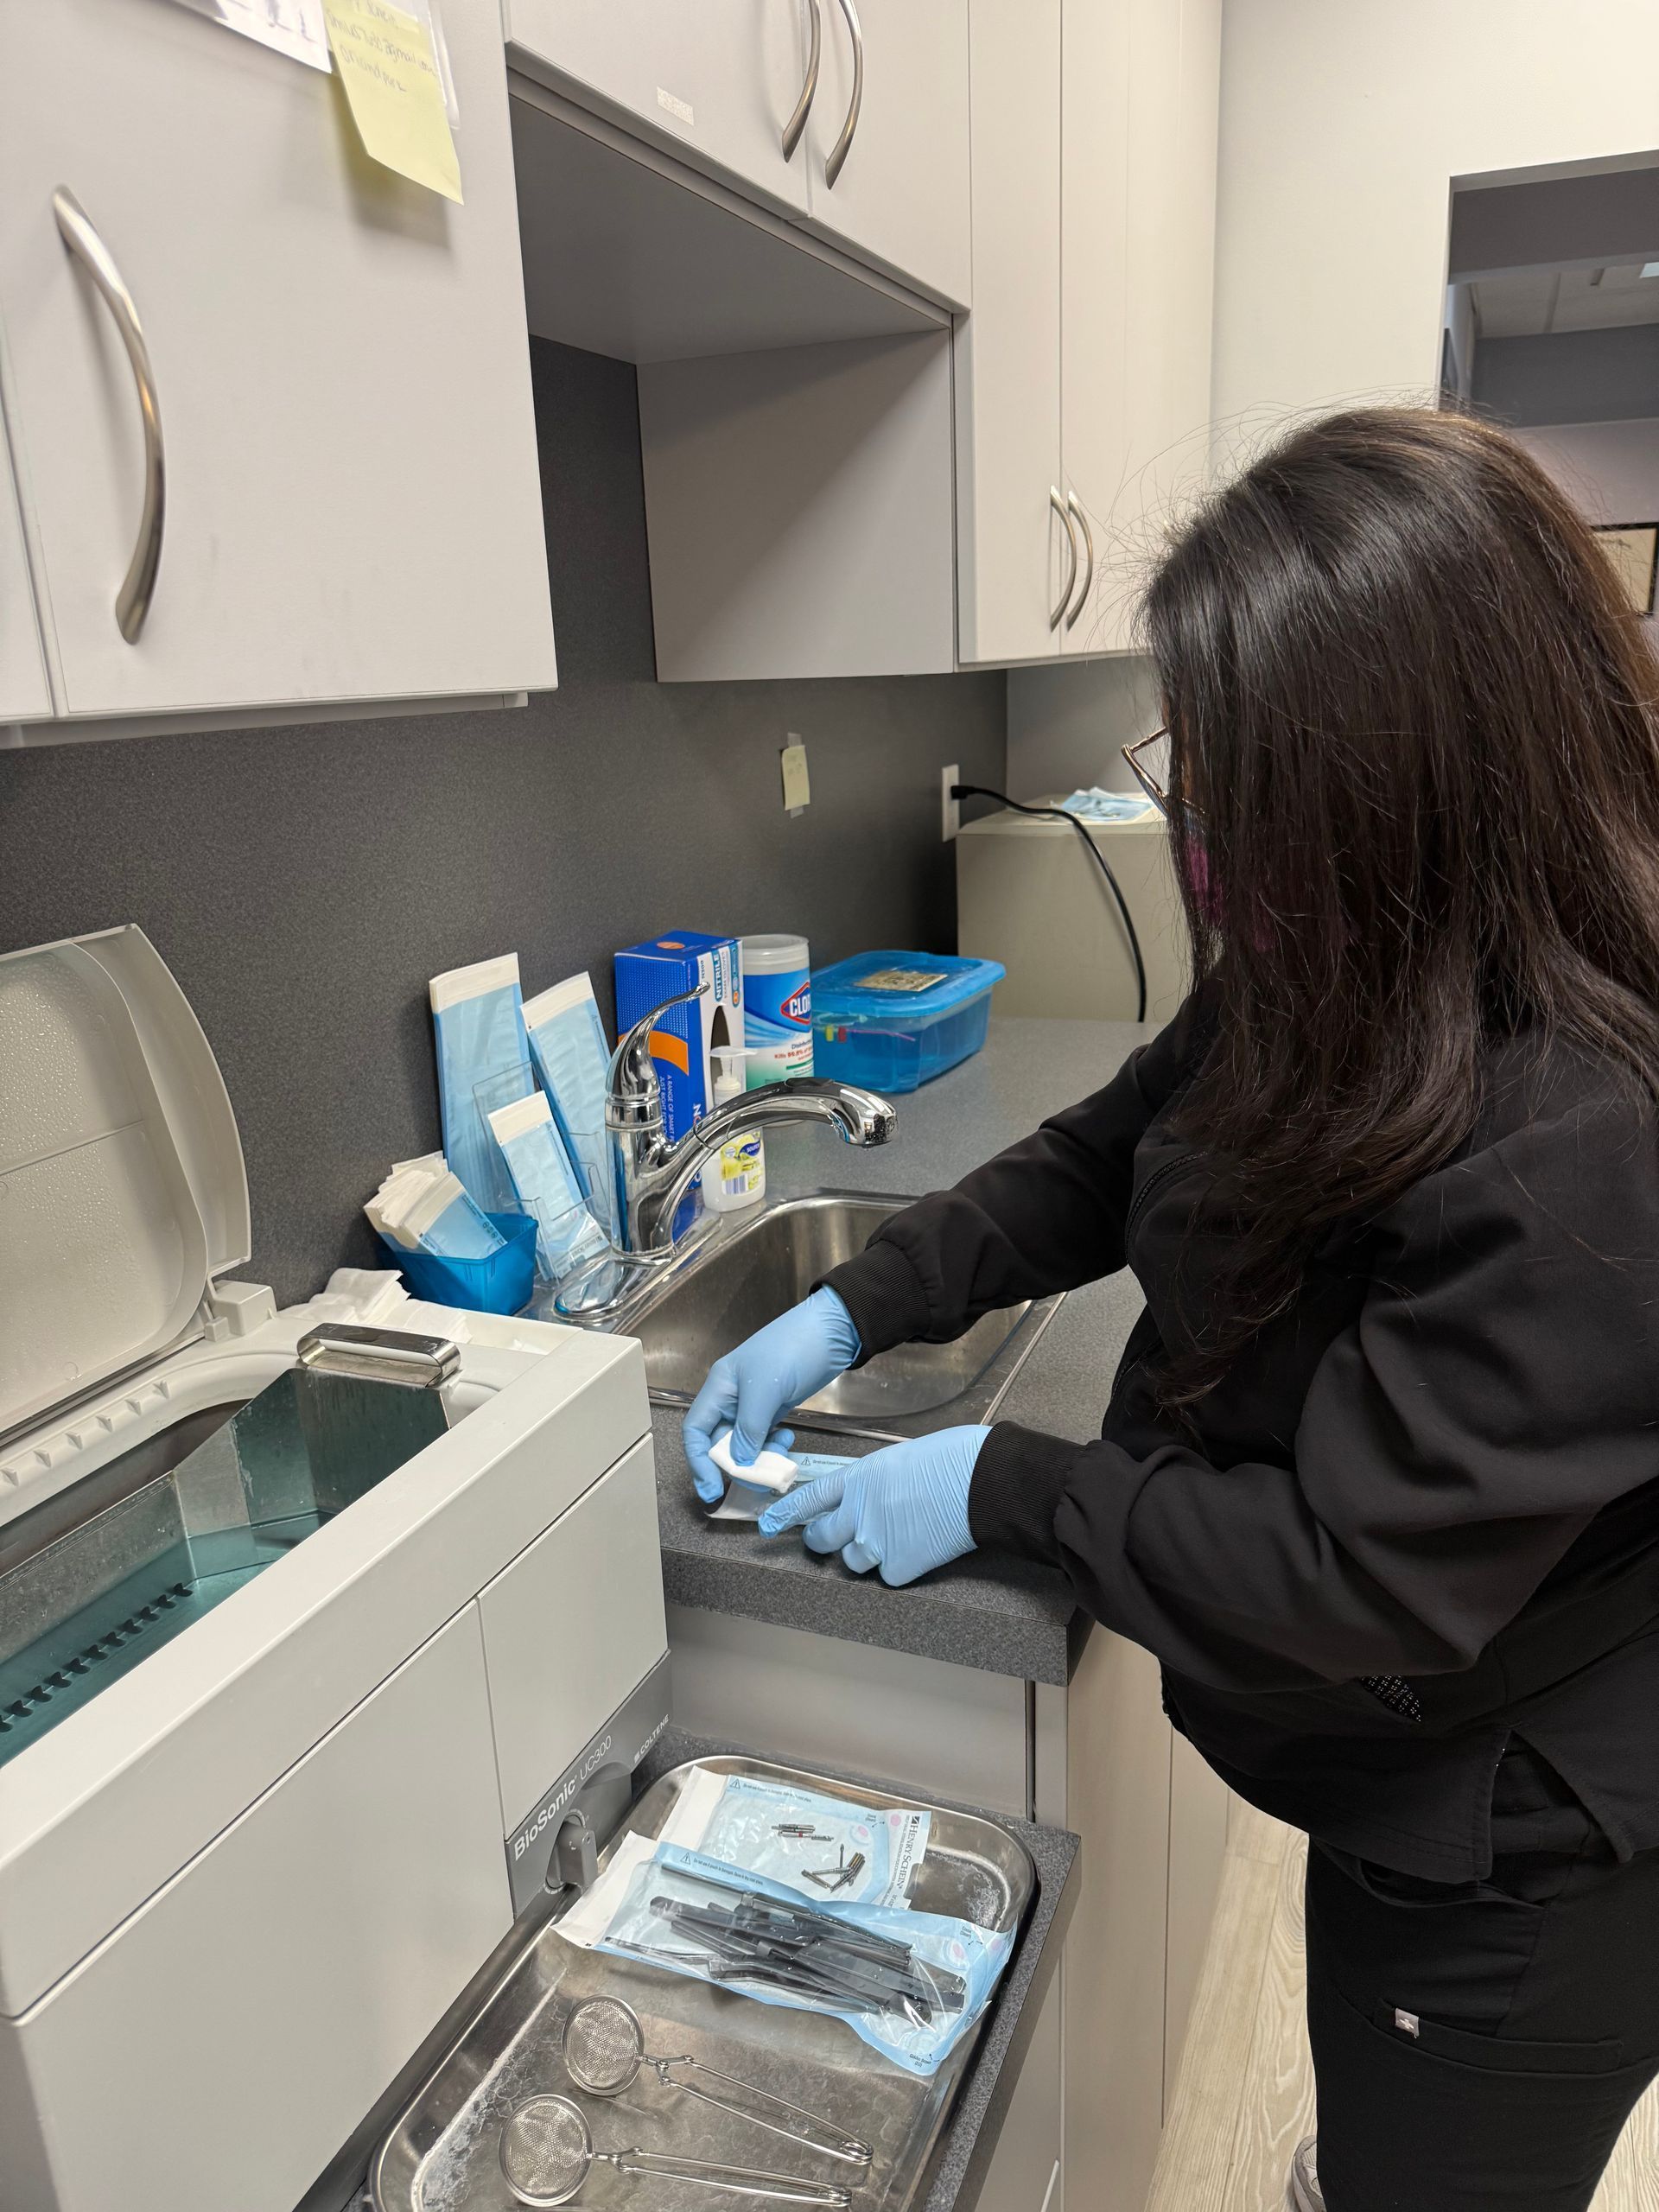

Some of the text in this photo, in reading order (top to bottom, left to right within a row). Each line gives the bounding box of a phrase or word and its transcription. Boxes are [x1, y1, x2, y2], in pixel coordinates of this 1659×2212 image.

[714, 953, 722, 999] NITRILE
[668, 1103, 674, 1112] OF
[640, 1714, 670, 1755] COLTENE
[514, 1735, 612, 1860] BioSonic UC300
[904, 1824, 918, 1854] HENRY
[897, 1854, 912, 1886] SCHEIN
